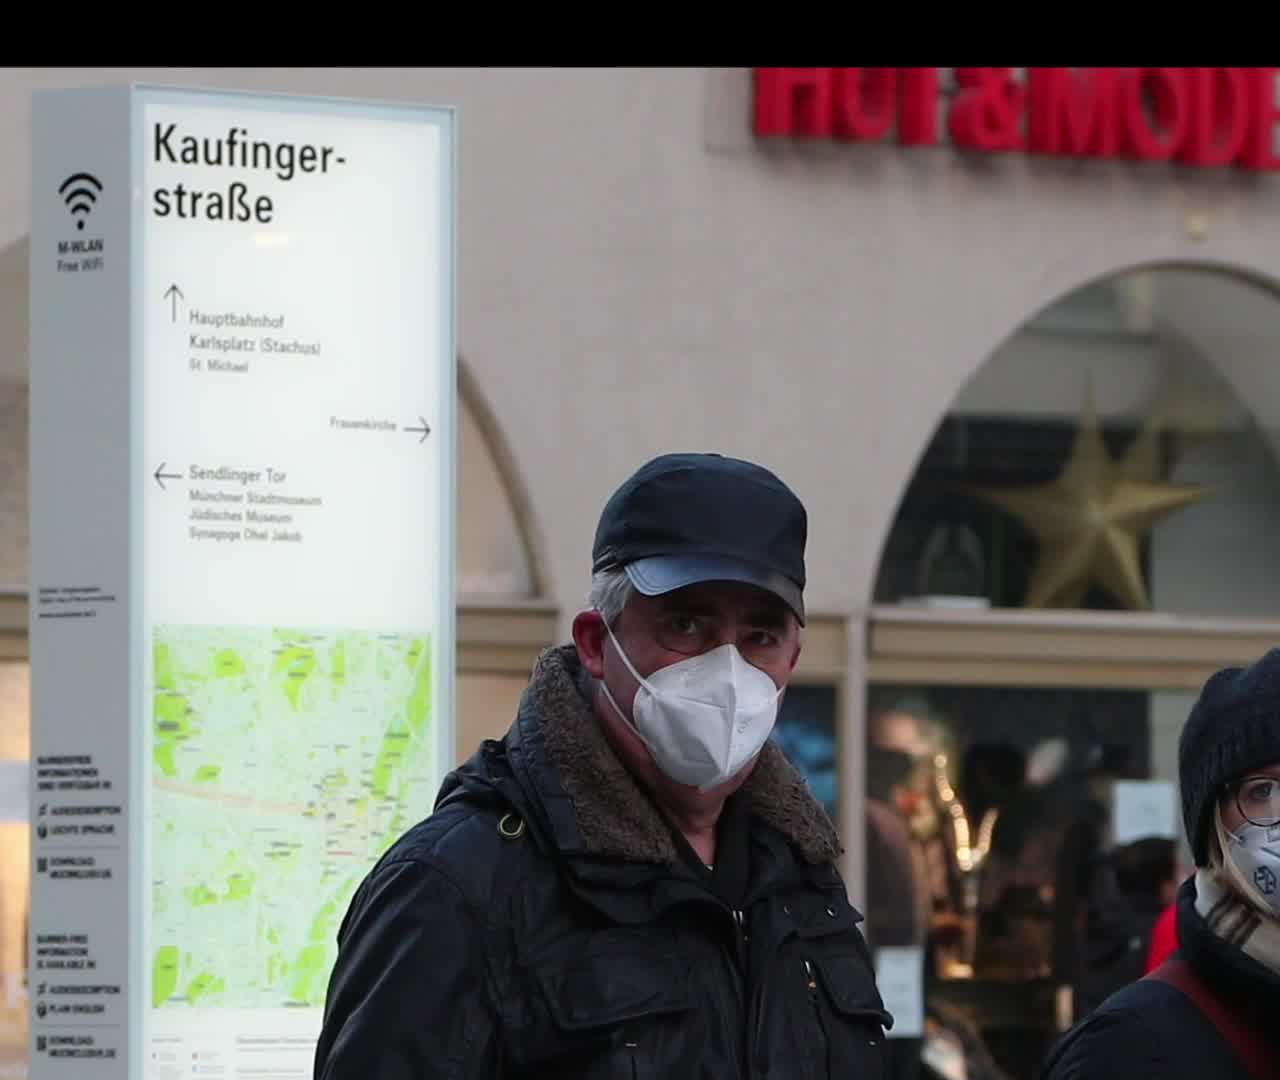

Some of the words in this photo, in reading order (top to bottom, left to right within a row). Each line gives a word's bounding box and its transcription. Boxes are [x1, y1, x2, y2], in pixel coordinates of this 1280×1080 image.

[153, 123, 347, 180] Kaufinger-
[153, 182, 274, 223] straße
[189, 309, 284, 328] Hauptbahnhof
[189, 334, 256, 353] Karlsplatz
[260, 337, 321, 357] (Stachus)
[189, 464, 261, 486] Sendlinger
[265, 467, 287, 483] Tor
